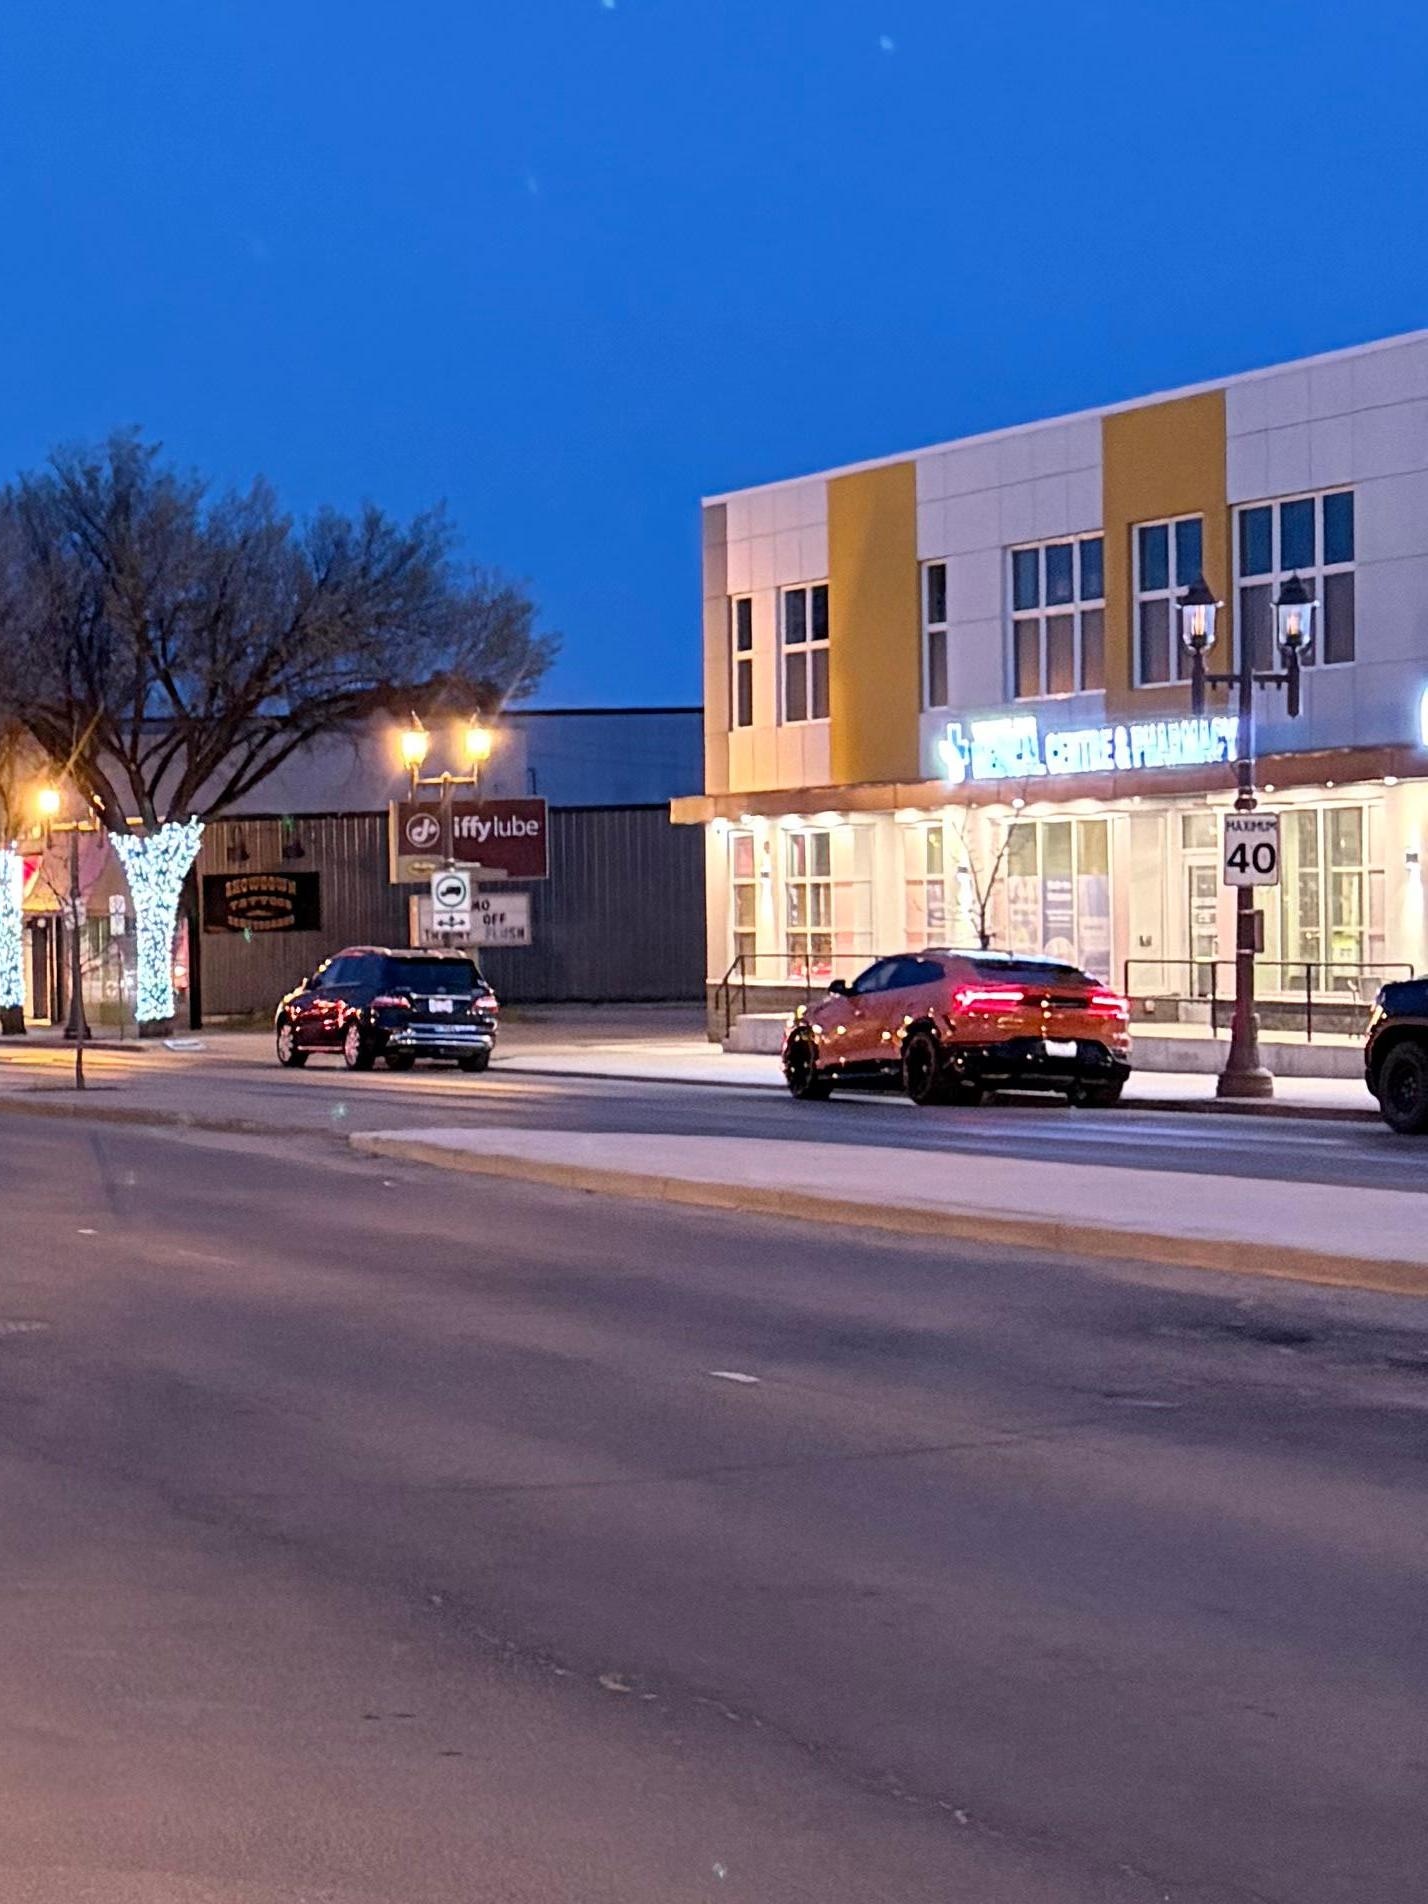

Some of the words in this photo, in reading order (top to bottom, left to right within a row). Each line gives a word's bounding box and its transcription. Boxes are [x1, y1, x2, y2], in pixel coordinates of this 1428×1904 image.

[1129, 716, 1238, 769] PHARMACY
[453, 816, 491, 843] iffy
[494, 815, 539, 837] lube
[1226, 820, 1277, 832] MAXIMUM
[1227, 843, 1276, 873] 40
[483, 913, 505, 926] OFF
